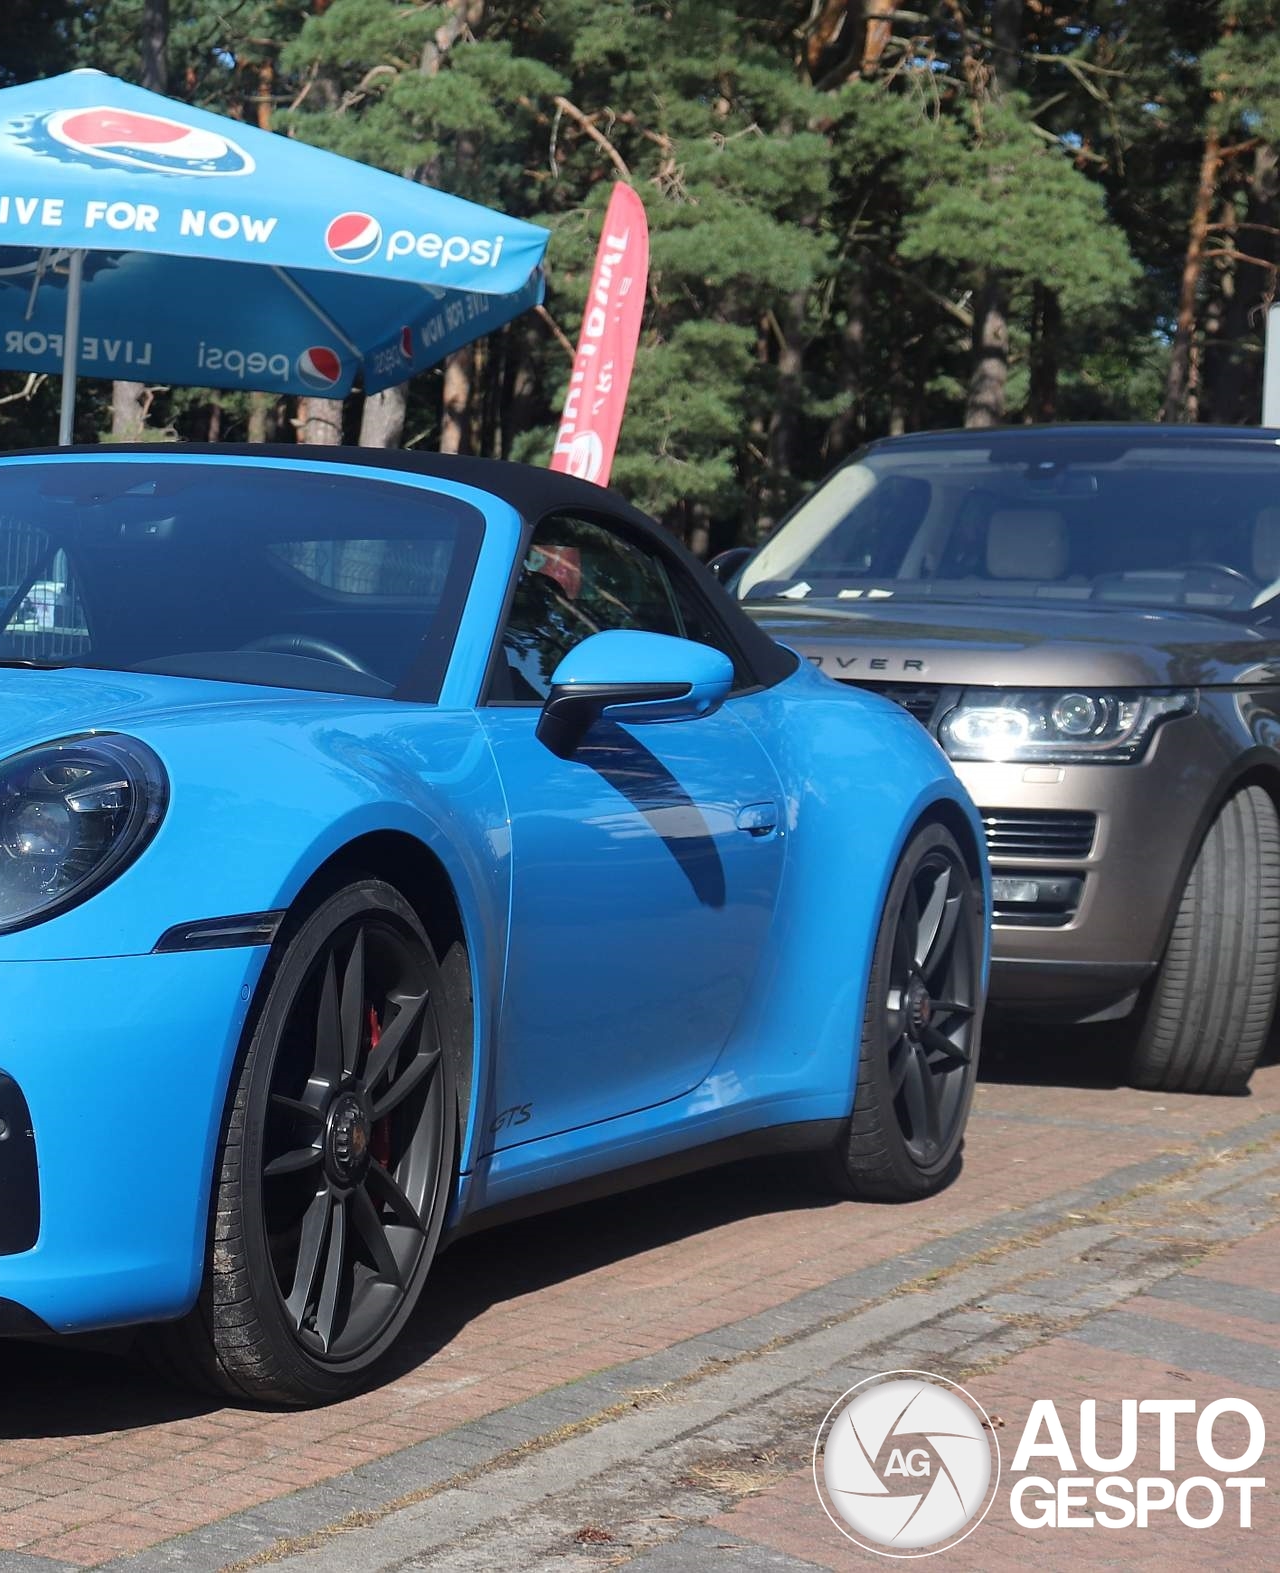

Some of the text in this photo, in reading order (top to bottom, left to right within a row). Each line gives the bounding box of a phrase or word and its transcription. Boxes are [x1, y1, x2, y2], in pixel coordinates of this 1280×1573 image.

[84, 201, 160, 232] FOR
[179, 208, 277, 243] NOW
[385, 230, 505, 268] pepsi
[489, 1102, 533, 1133] GTS
